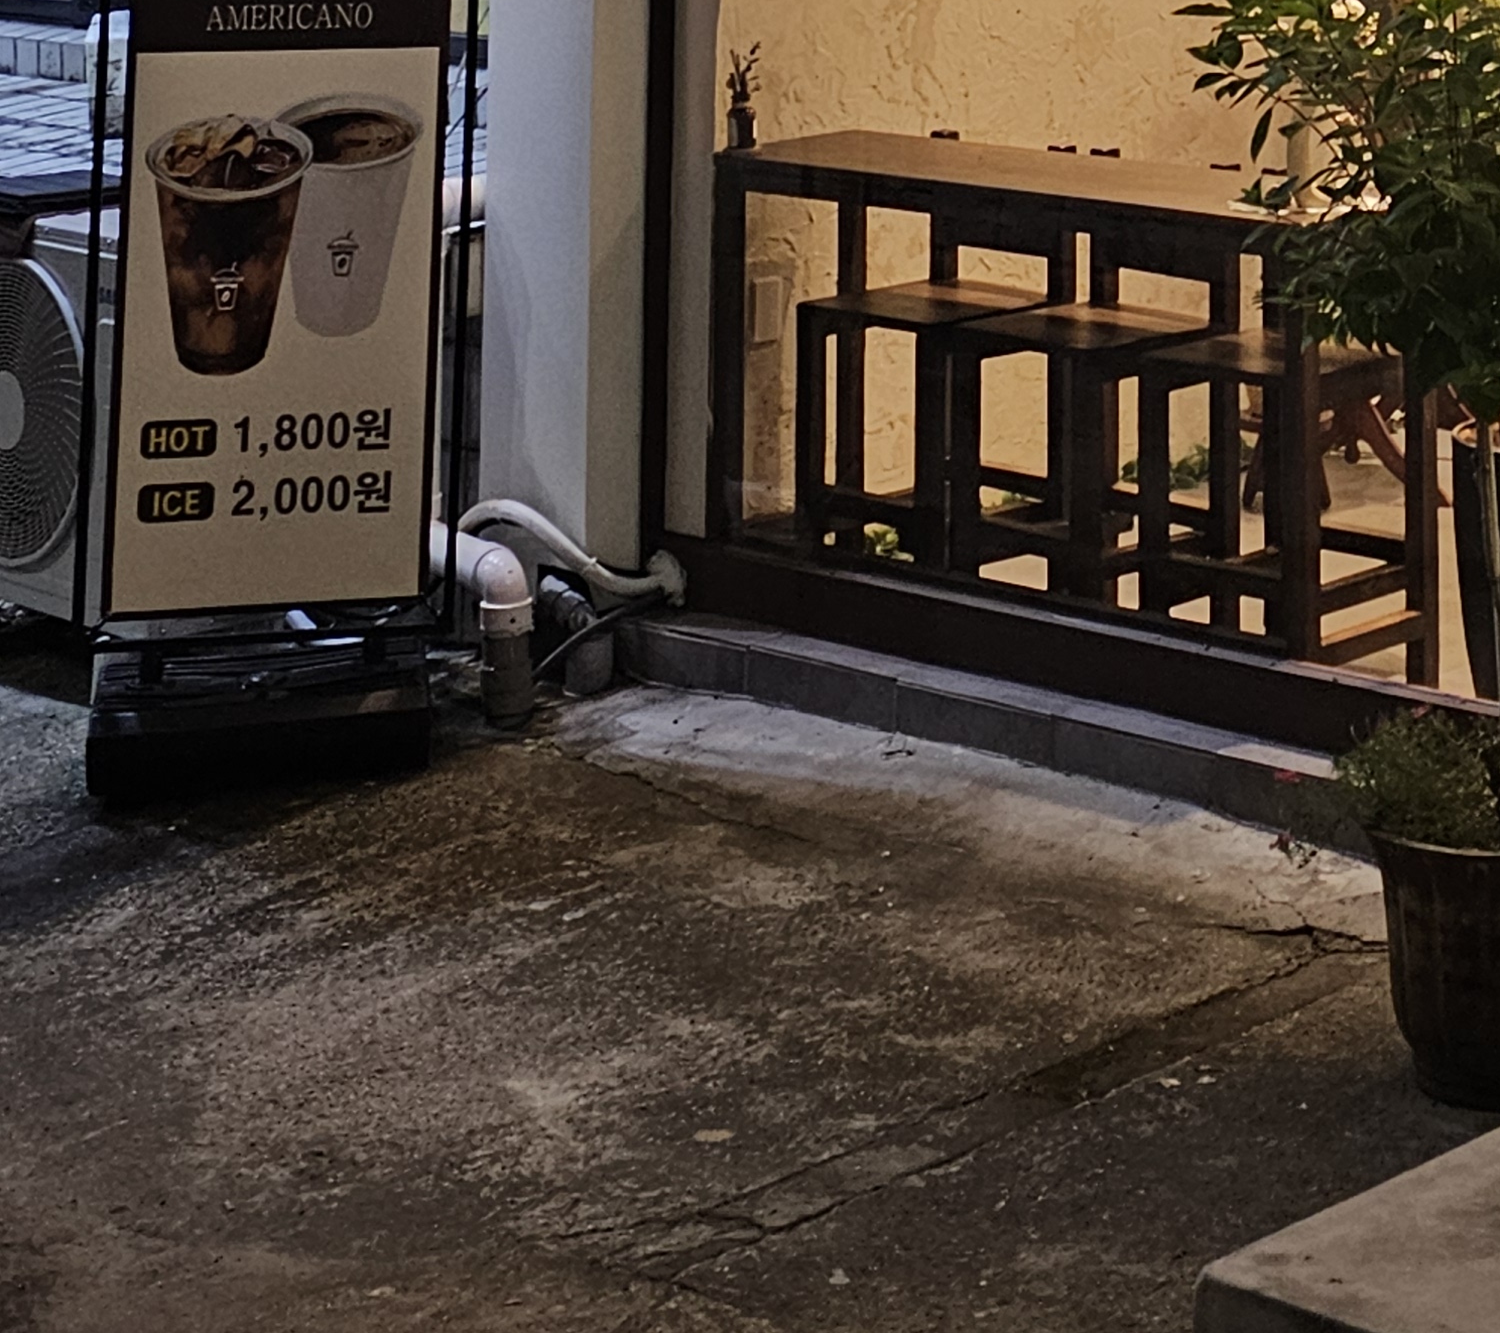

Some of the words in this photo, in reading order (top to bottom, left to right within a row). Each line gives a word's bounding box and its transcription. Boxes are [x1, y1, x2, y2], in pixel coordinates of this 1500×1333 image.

[205, 1, 375, 33] AMERICANO
[148, 425, 212, 453] HOT
[233, 407, 392, 458] 1,800원
[151, 488, 202, 517] ICE
[230, 469, 392, 522] 2,000원
